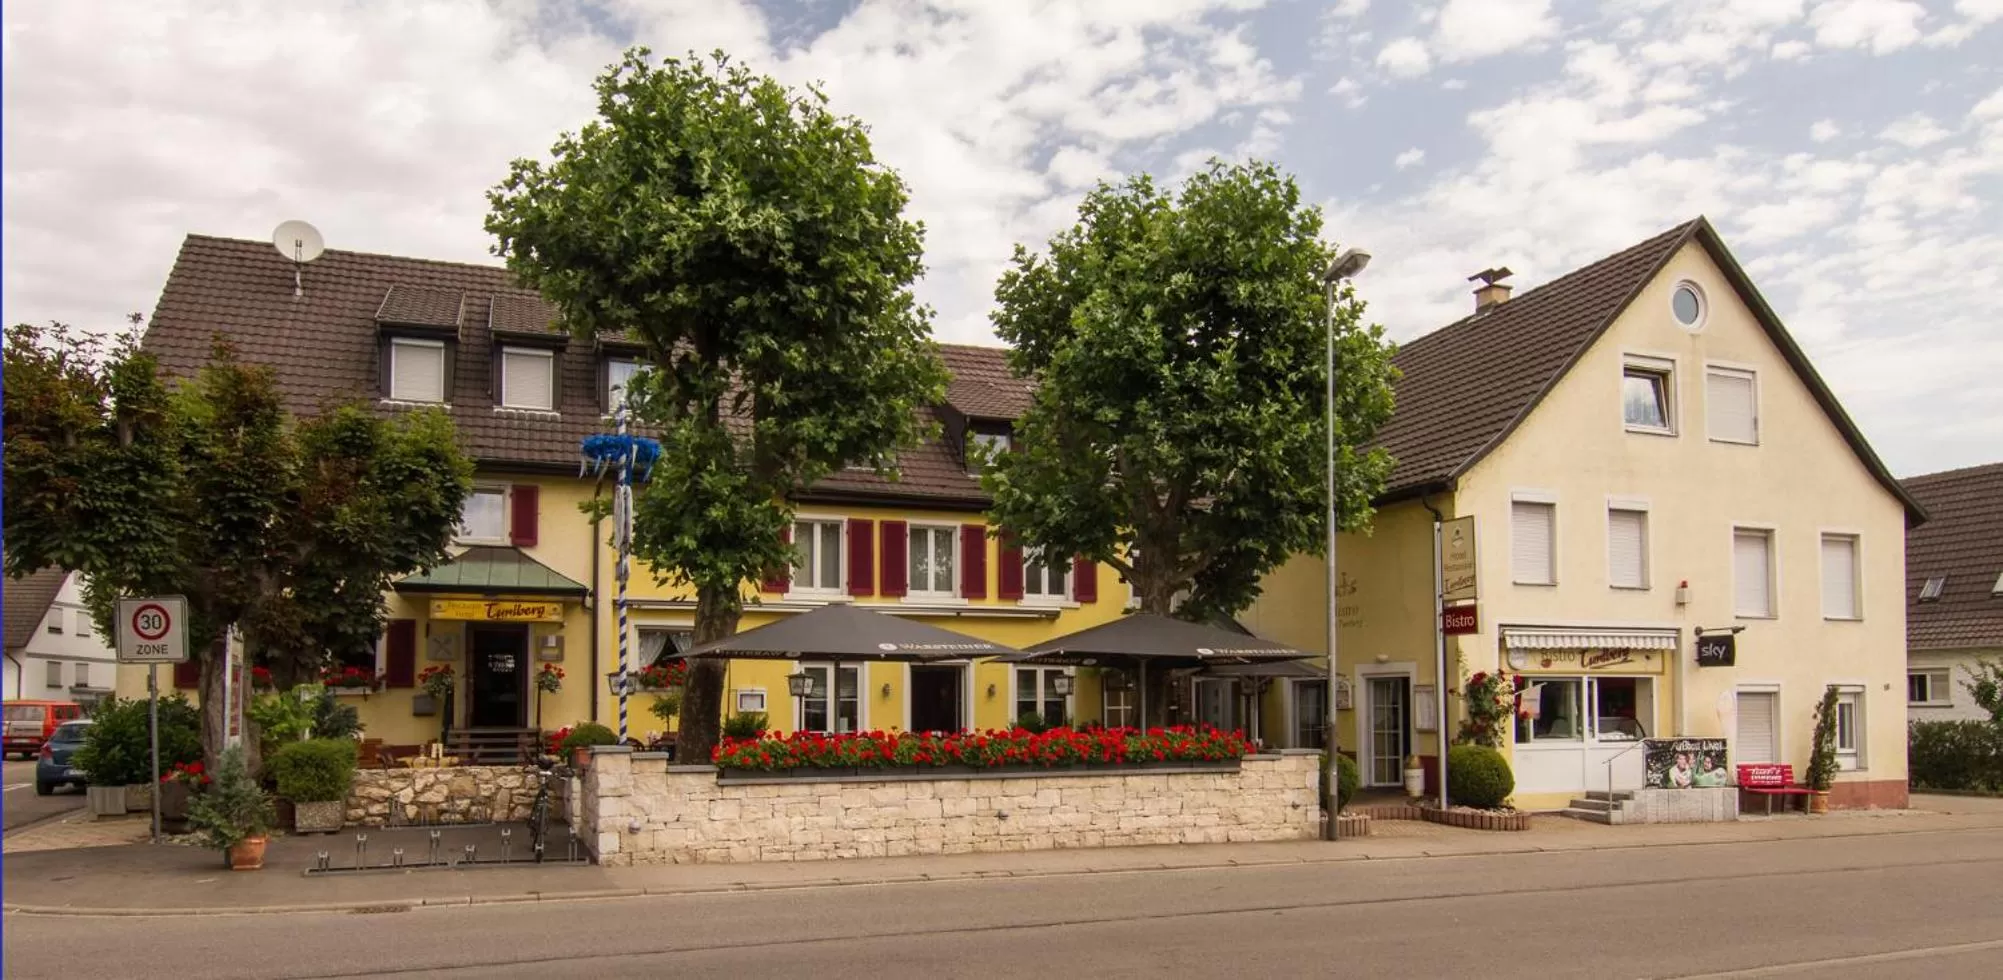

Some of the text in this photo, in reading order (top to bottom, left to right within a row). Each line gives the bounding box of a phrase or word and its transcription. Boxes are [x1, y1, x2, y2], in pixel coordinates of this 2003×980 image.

[140, 614, 162, 630] 30
[1445, 614, 1475, 629] Bistro
[136, 644, 169, 655] ZONE
[1702, 643, 1727, 660] sky
